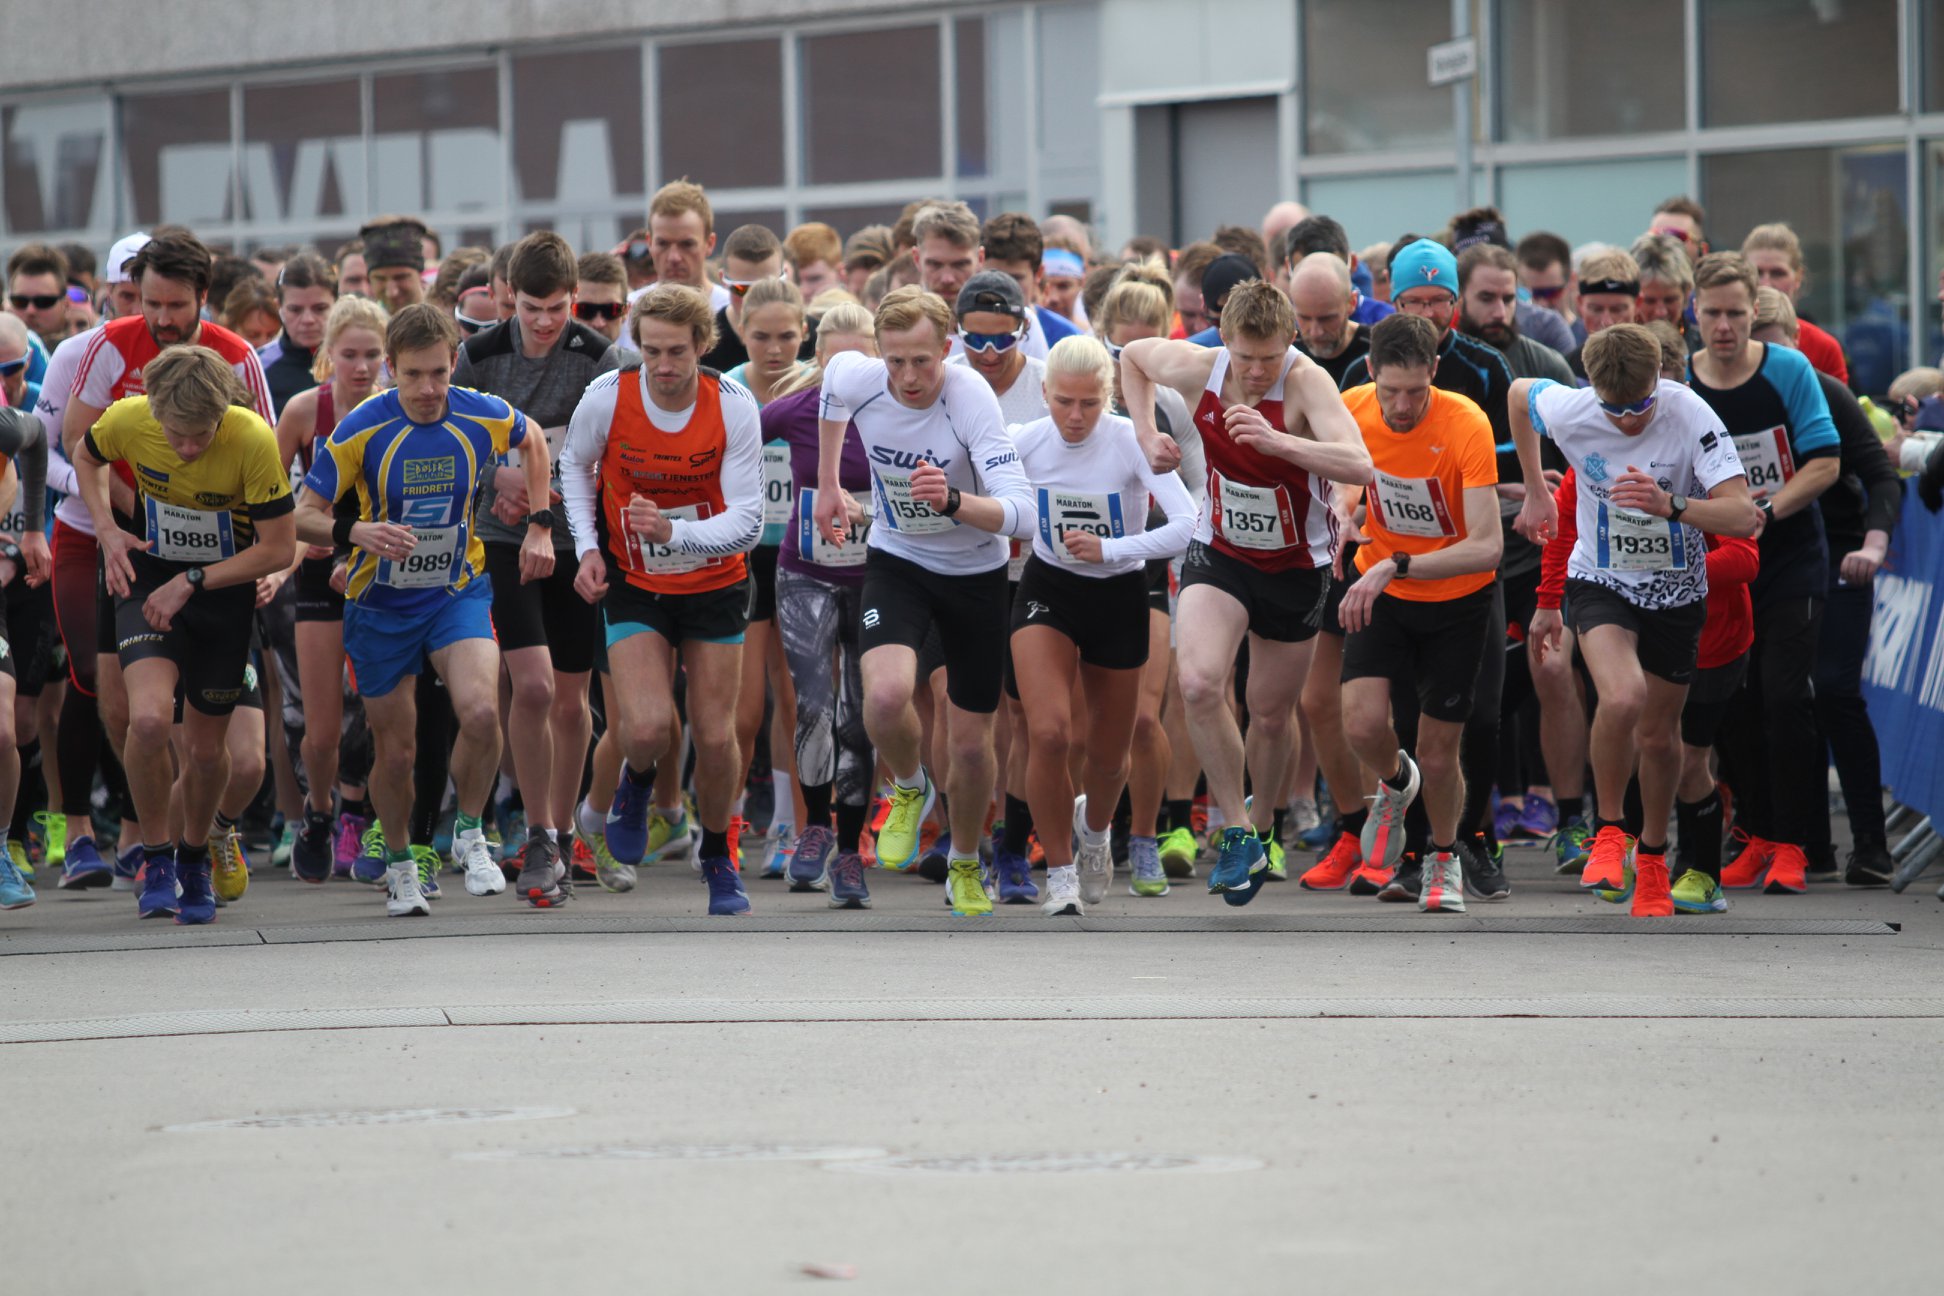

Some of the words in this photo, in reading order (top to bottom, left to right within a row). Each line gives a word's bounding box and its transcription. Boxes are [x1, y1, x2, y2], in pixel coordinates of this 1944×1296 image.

[764, 455, 783, 463] ATON
[403, 483, 454, 495] FRIIDRETT
[884, 479, 913, 488] MARATO
[1380, 478, 1413, 491] MARATON
[764, 480, 792, 502] 01
[1225, 488, 1260, 500] MARATON
[1056, 499, 1093, 508] MARATON
[164, 509, 201, 521] MARATON
[1383, 499, 1434, 522] 1168
[1225, 509, 1277, 532] 1357
[1615, 515, 1652, 526] MARATON
[161, 528, 218, 548] 1988
[414, 534, 443, 542] RATON
[821, 521, 871, 546] 47
[1612, 535, 1669, 554] 1933
[400, 552, 452, 573] 1989
[119, 634, 164, 650] TRIMTEX
